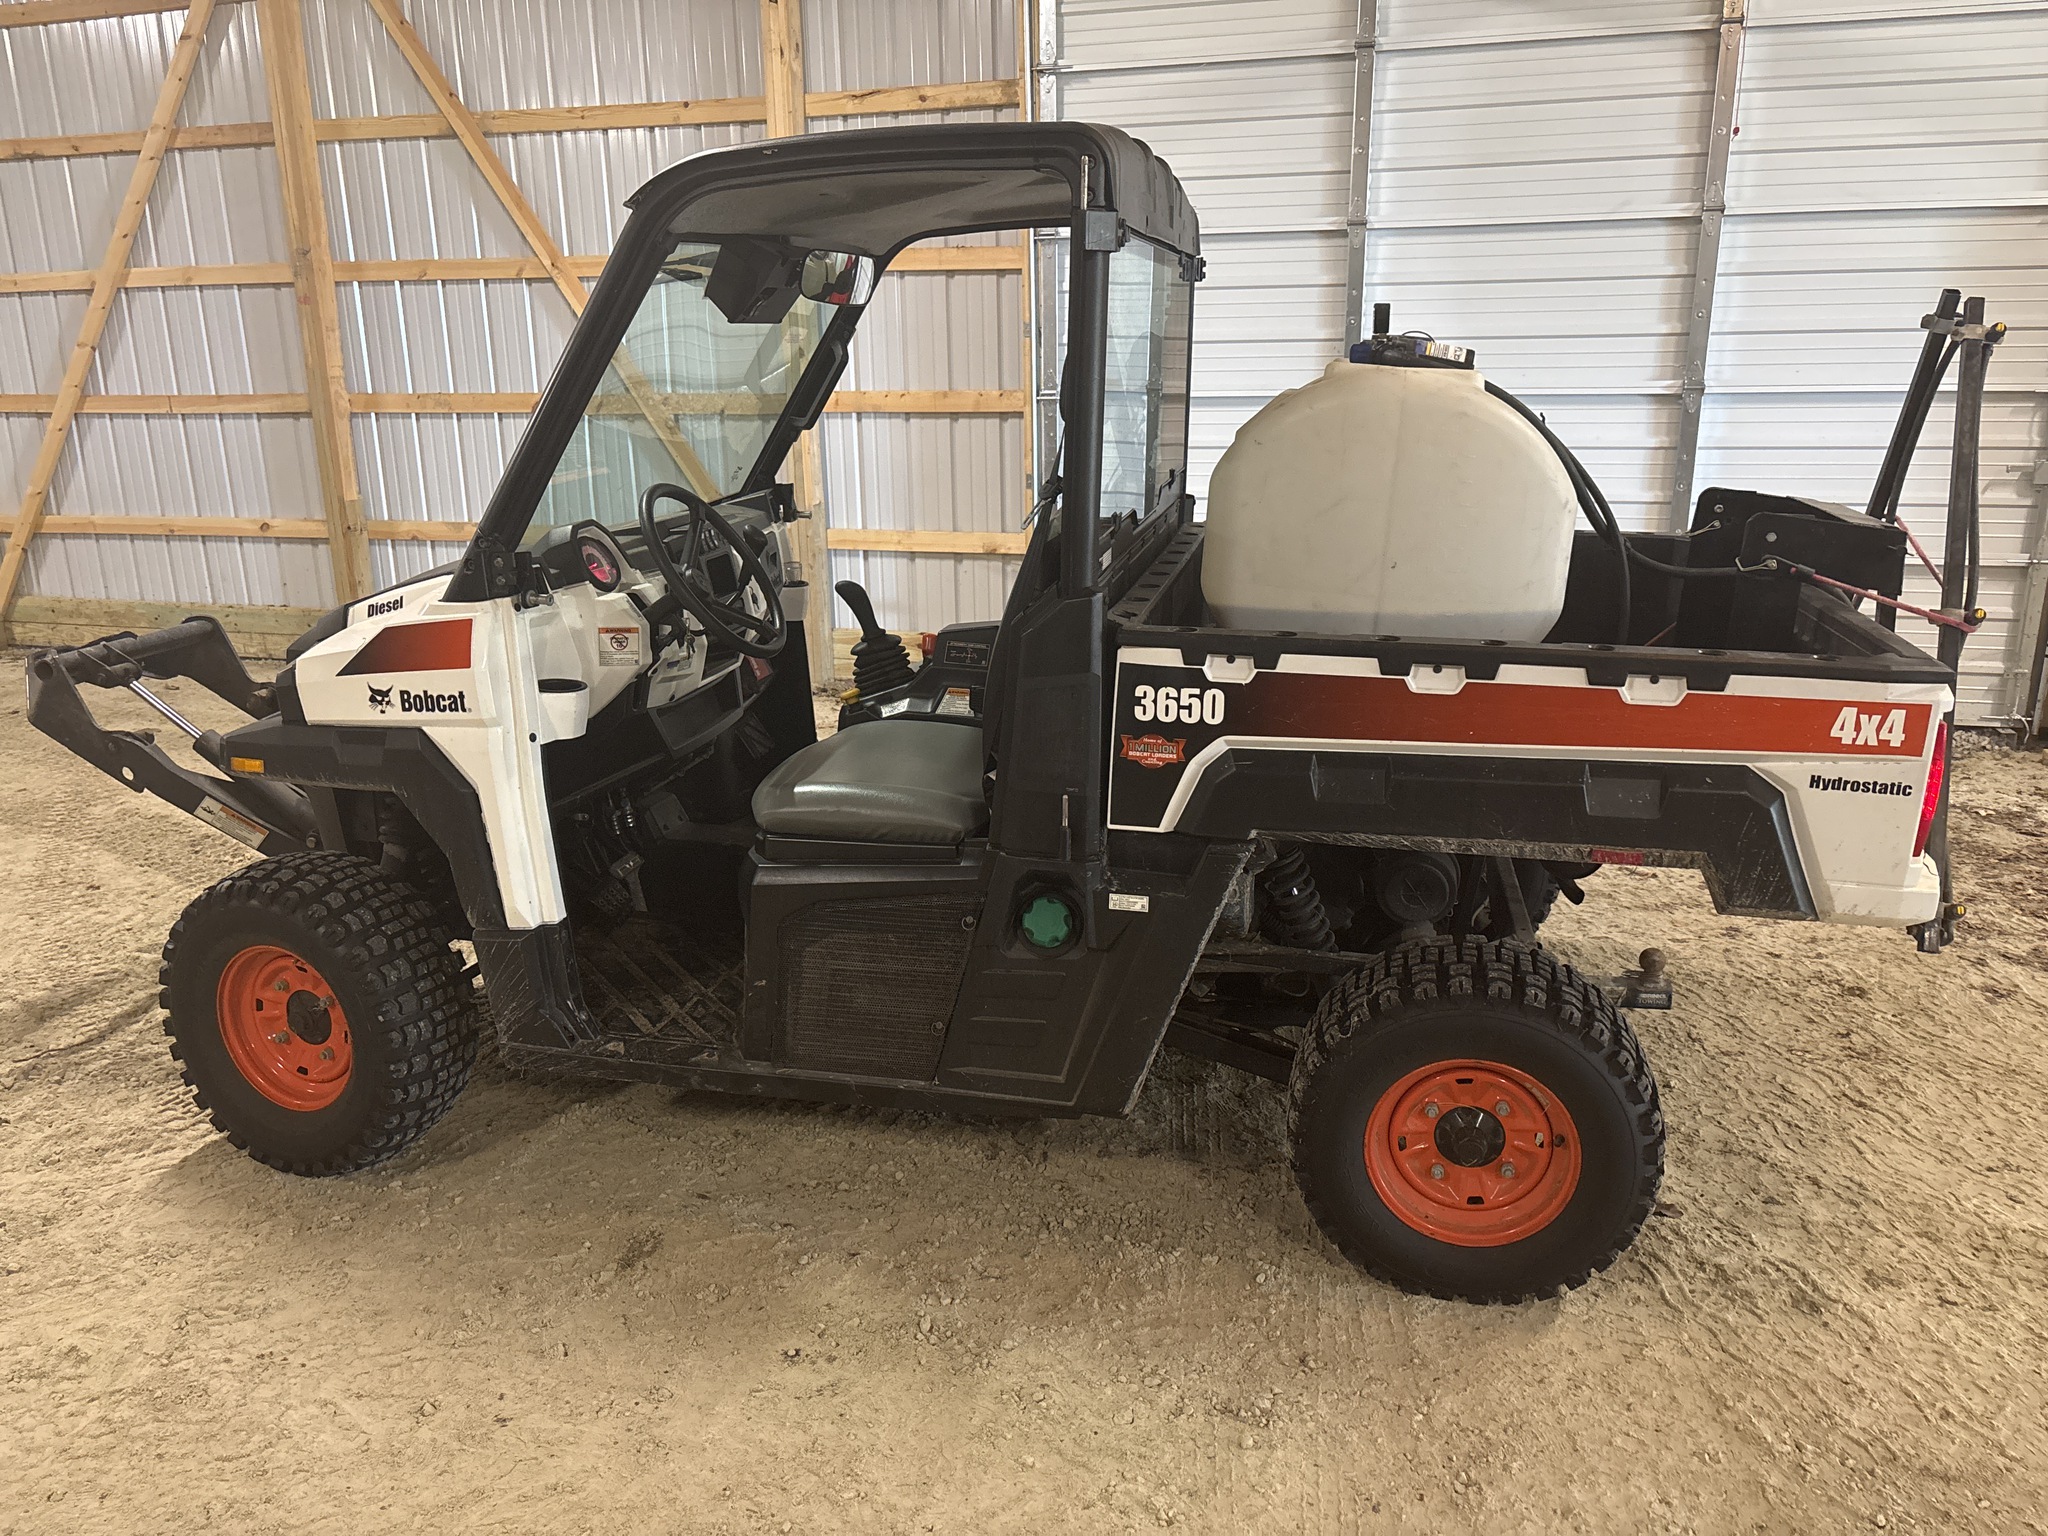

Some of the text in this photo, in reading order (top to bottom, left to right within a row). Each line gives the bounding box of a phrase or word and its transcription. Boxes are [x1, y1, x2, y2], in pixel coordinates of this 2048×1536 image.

[367, 595, 404, 618] Diesel
[399, 689, 467, 713] Bobcat
[1134, 684, 1225, 725] 3650
[1830, 706, 1907, 747] 4x4
[1128, 742, 1177, 754] 1 MILLION
[1808, 774, 1913, 797] Hydrostatic
